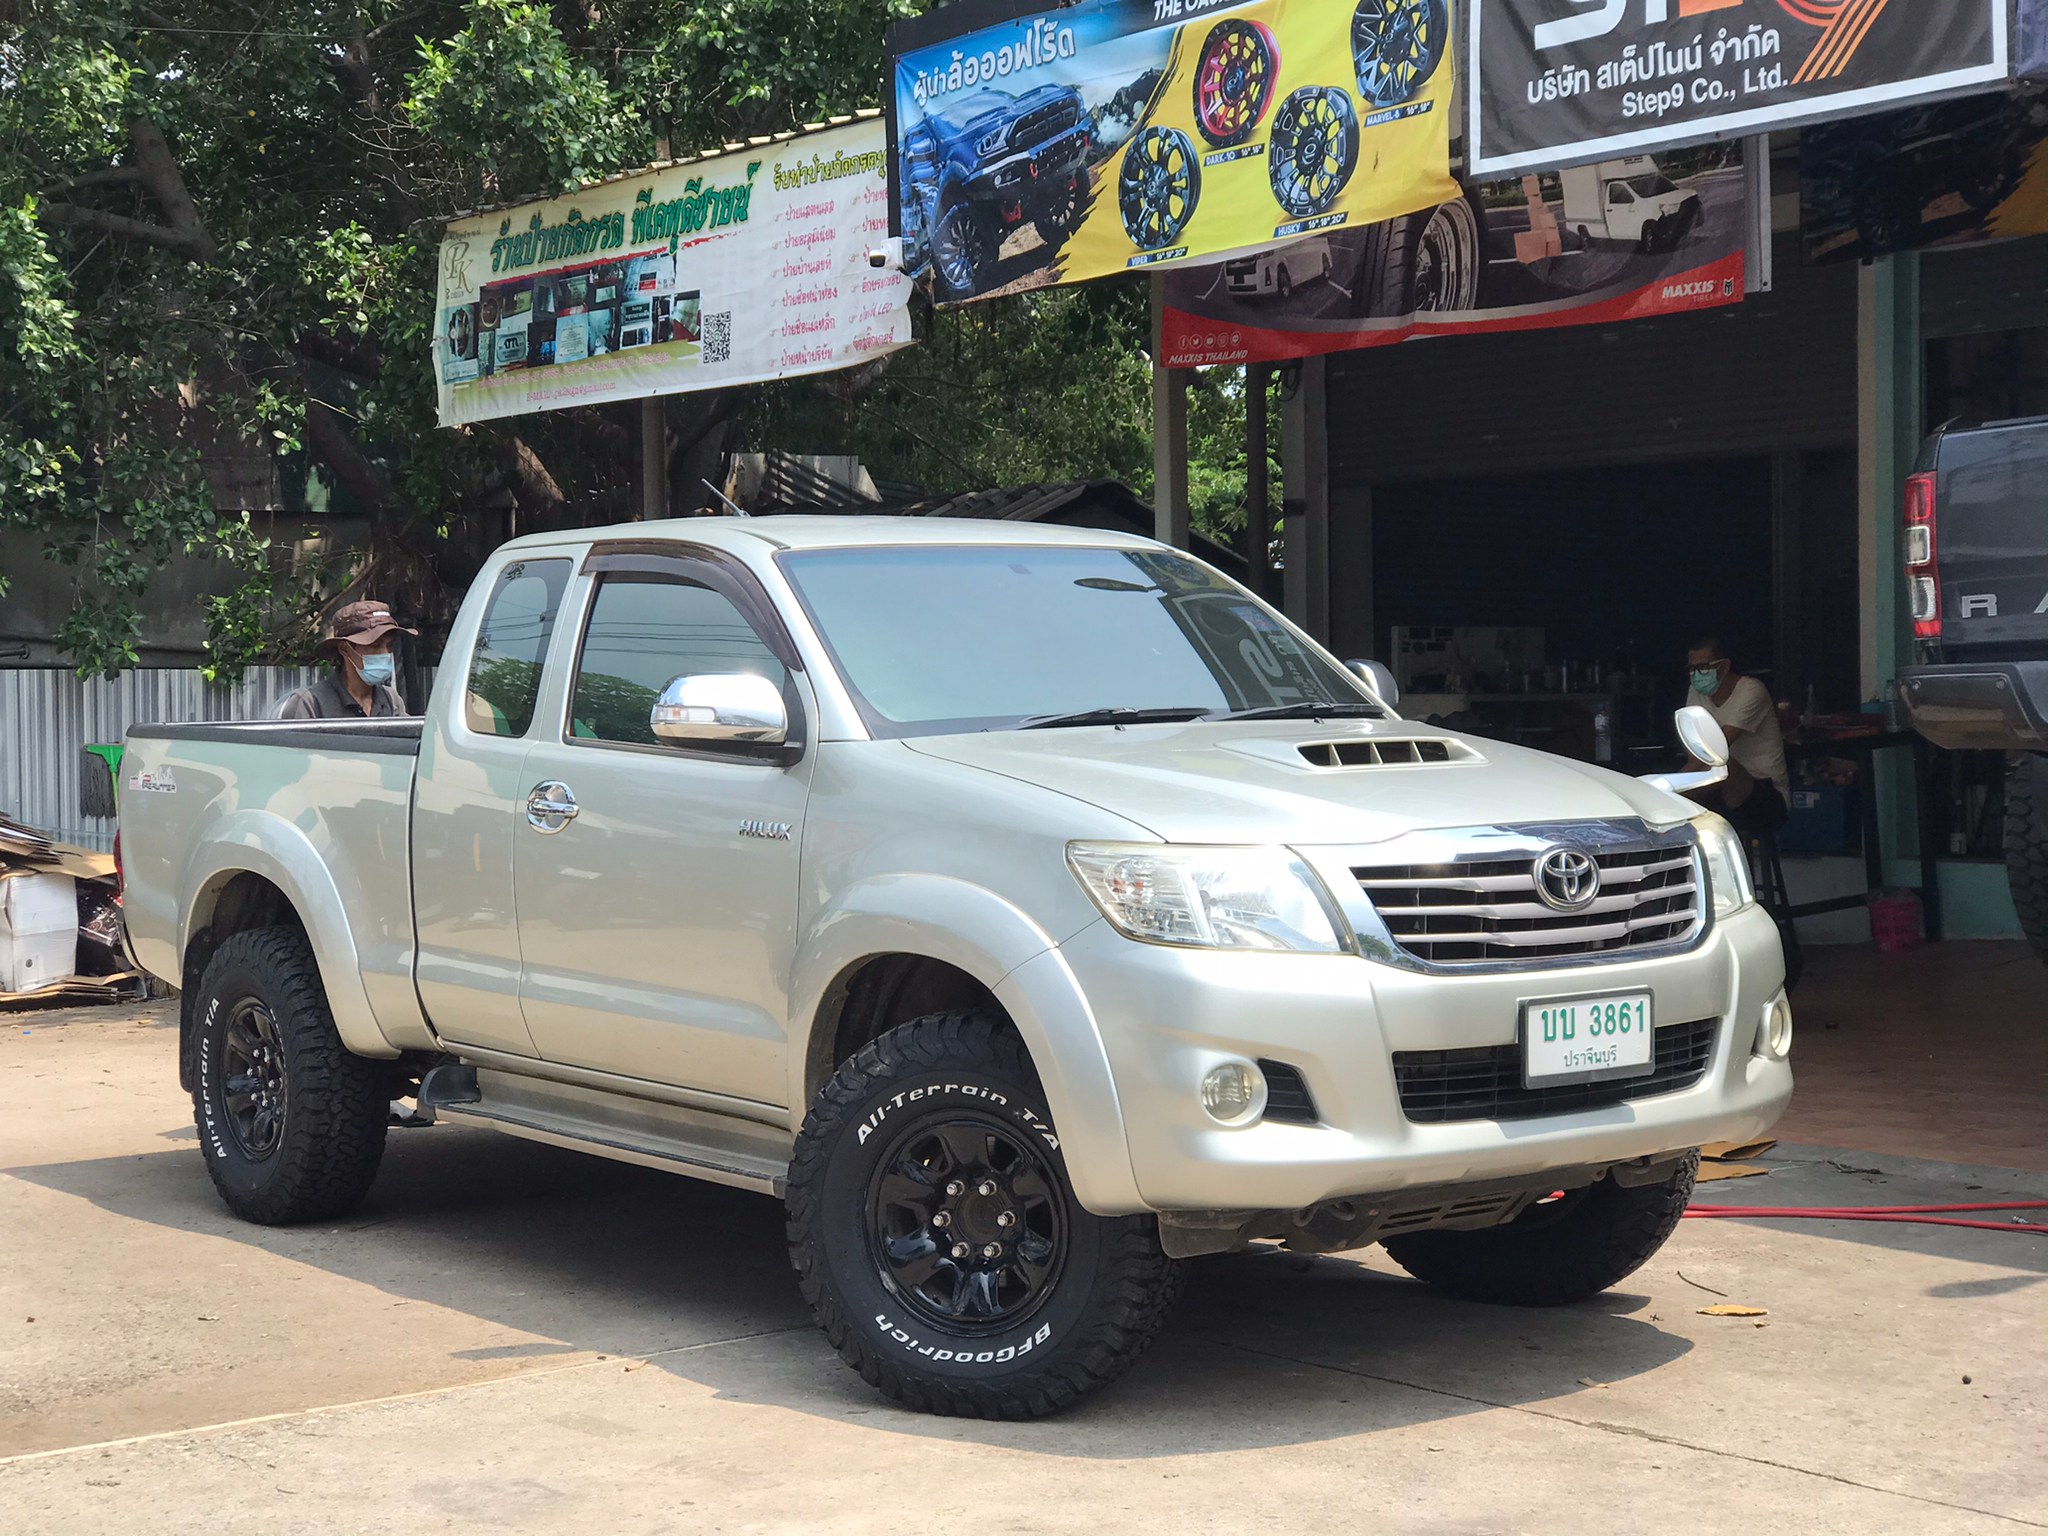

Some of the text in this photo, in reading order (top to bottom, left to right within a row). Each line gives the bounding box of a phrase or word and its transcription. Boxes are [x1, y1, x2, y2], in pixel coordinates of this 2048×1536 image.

[1527, 64, 1590, 103] บริษัท
[1597, 34, 1702, 90] สเต็ปไนน์
[1709, 24, 1780, 68] จำกัด
[1622, 63, 1788, 118] Step9 Co., Ltd.
[1278, 223, 1301, 236] HUSKY
[1662, 280, 1715, 299] MAXXIS
[1168, 350, 1248, 364] MAXXIS THAILAND
[739, 819, 792, 840] HILUX
[1589, 1000, 1644, 1036] 3861
[1564, 1045, 1617, 1067] ปราจีนบุรี
[201, 997, 228, 1158] All-Terrain T/A
[857, 1083, 1059, 1150] All-Terrain T/A
[874, 1314, 1052, 1363] BFGoodrich
